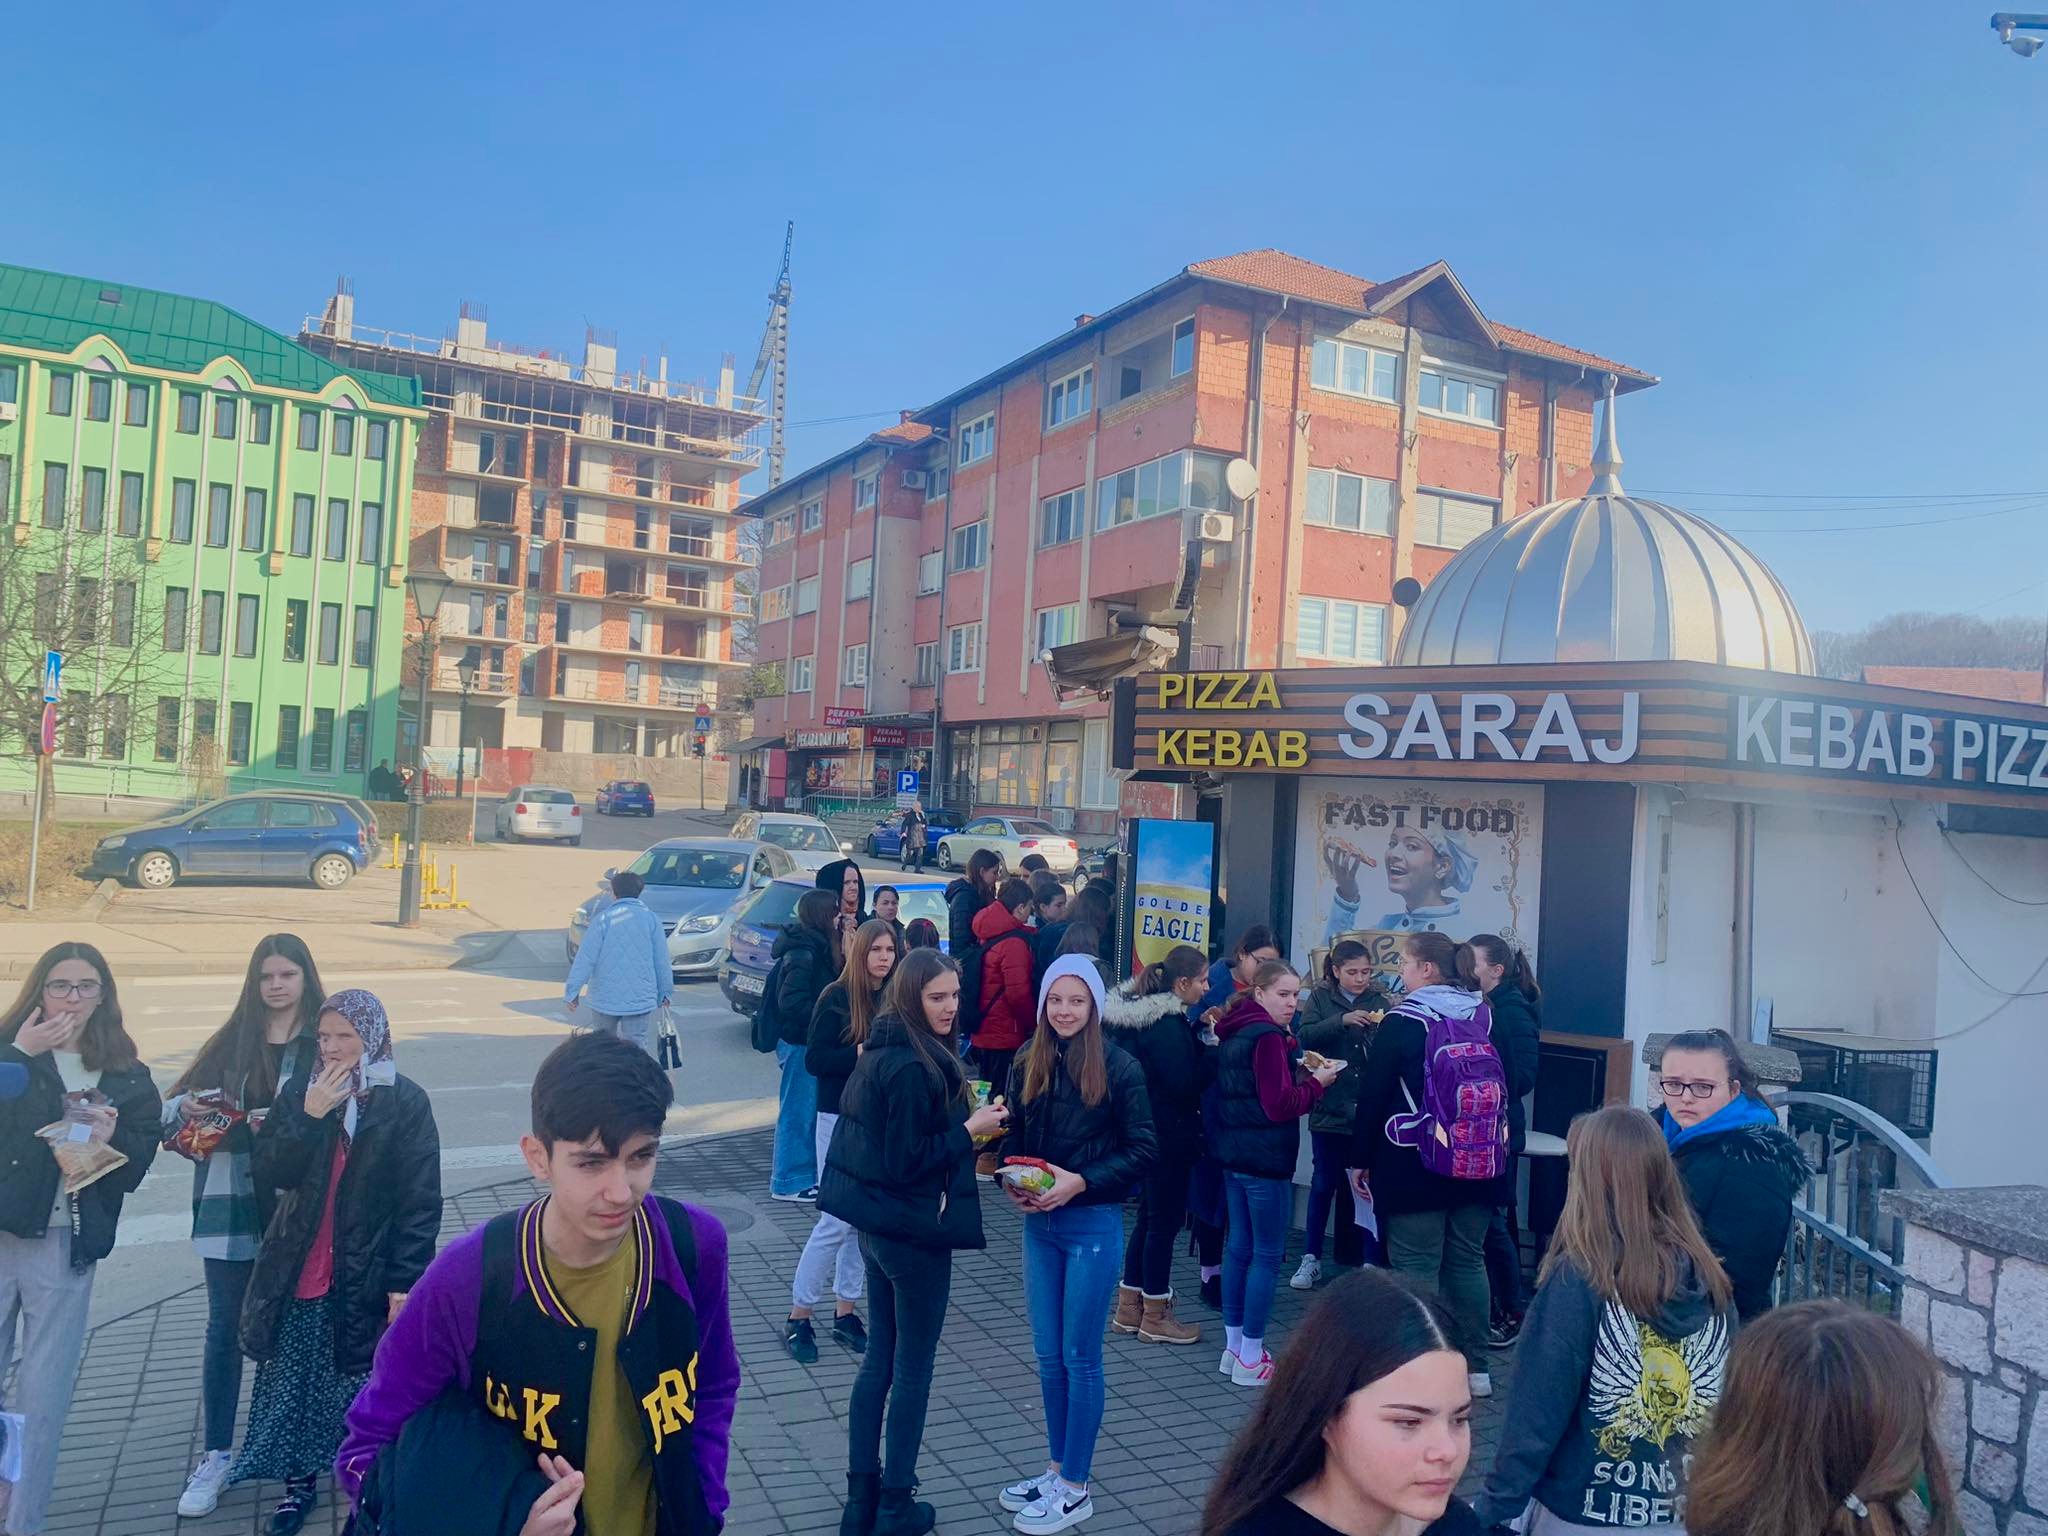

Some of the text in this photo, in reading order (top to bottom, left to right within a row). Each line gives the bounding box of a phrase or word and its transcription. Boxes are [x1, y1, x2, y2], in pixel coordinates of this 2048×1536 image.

[1159, 672, 1281, 709] PIZZA
[1338, 691, 1639, 764] SARAJ
[1736, 695, 2048, 788] KEBAB PIZZ
[1157, 729, 1308, 768] KEBAB
[902, 774, 913, 790] P
[1325, 803, 1515, 833] FAST FOOD
[1138, 897, 1212, 917] GOLDE
[1142, 915, 1203, 943] EAGLE
[1372, 936, 1401, 966] Sa
